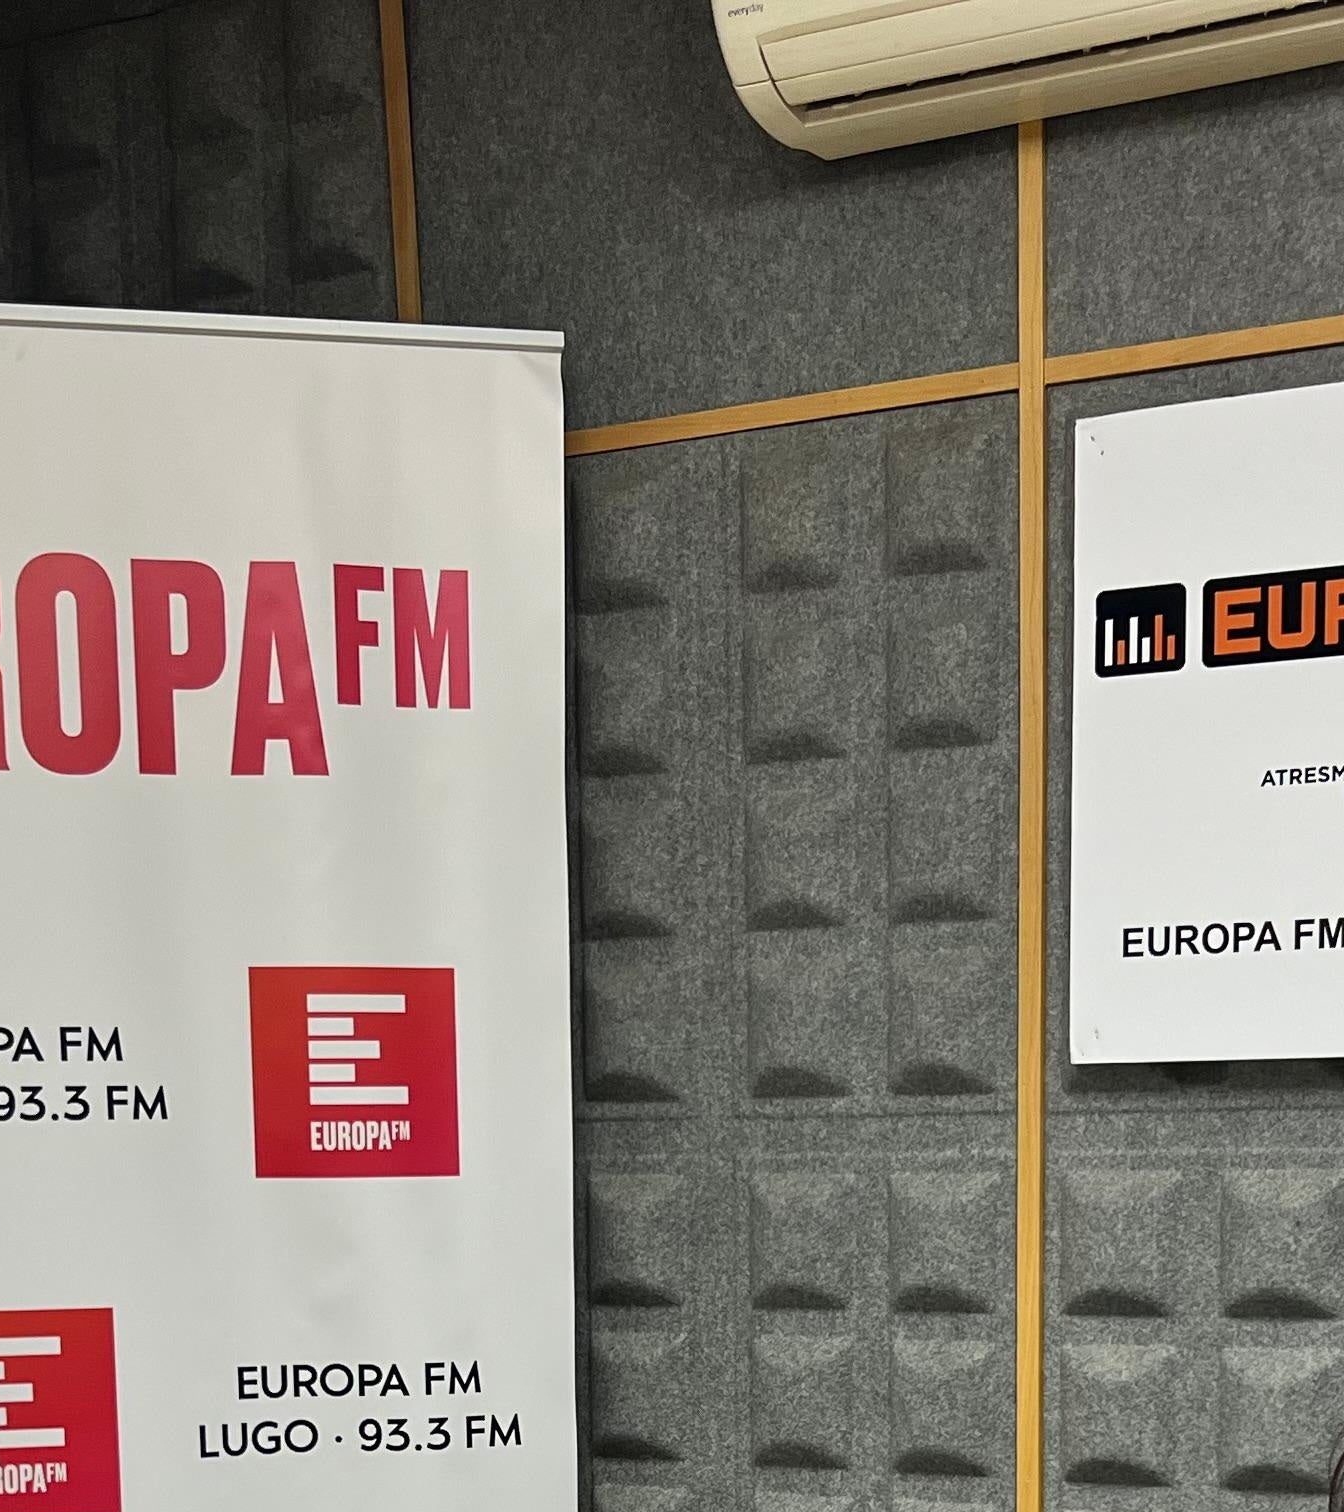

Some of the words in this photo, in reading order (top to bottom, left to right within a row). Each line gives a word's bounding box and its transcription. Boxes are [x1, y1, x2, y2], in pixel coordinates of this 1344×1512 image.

[1123, 921, 1283, 959] EUROPA
[60, 1027, 124, 1063] FM
[107, 1086, 169, 1121] FM
[238, 1364, 411, 1401] EUROPA
[425, 1361, 483, 1397] FM
[200, 1420, 320, 1460] LUGO
[359, 1418, 452, 1453] 93.3
[466, 1414, 523, 1450] FM
